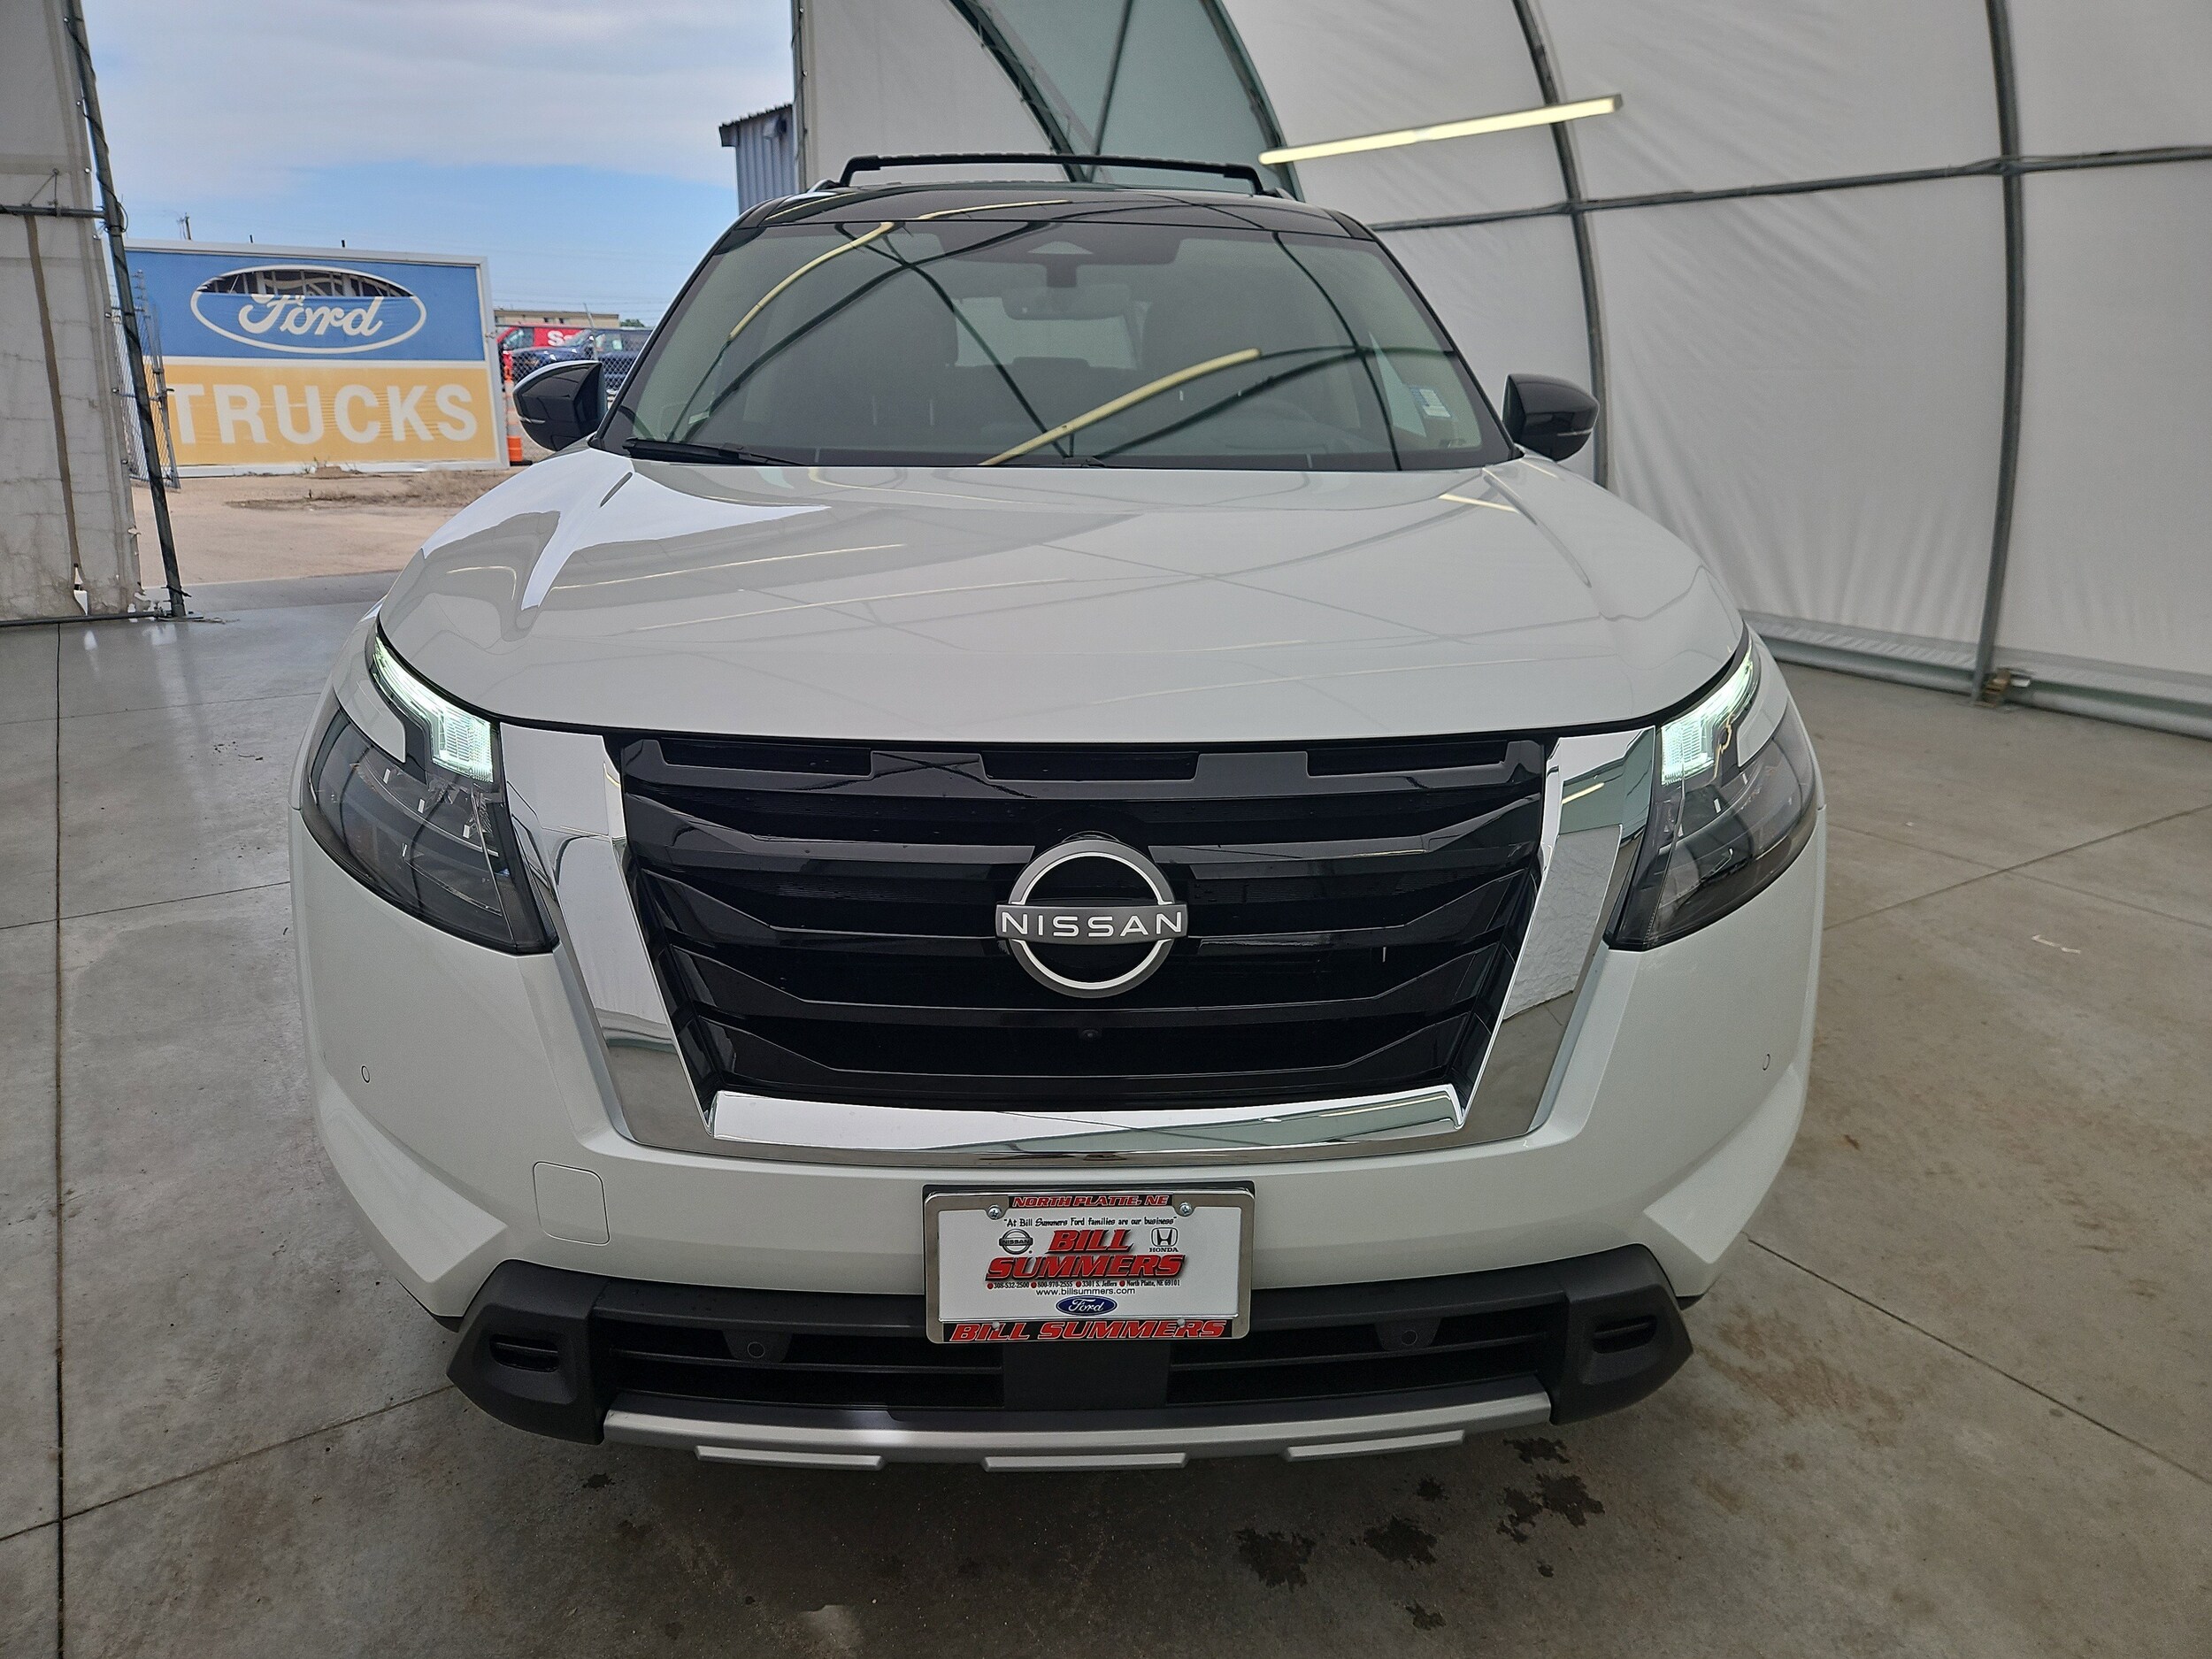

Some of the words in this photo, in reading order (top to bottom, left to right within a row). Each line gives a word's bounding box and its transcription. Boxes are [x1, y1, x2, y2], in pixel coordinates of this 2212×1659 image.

[238, 294, 383, 335] Ford
[169, 384, 478, 444] TRUCKS
[1002, 911, 1182, 938] NISSAN
[1012, 1196, 1072, 1208] NORTH
[1144, 1194, 1169, 1206] NE
[1019, 1217, 1033, 1226] Bill
[1034, 1217, 1068, 1227] Summers
[1070, 1217, 1085, 1226] Ford
[1087, 1217, 1115, 1225] families
[1044, 1229, 1134, 1254] BILL
[985, 1254, 1187, 1281] SUMMERS
[1068, 1298, 1104, 1312] Ford
[949, 1322, 1031, 1342] BILL
[1038, 1319, 1226, 1340] SUMMERS
